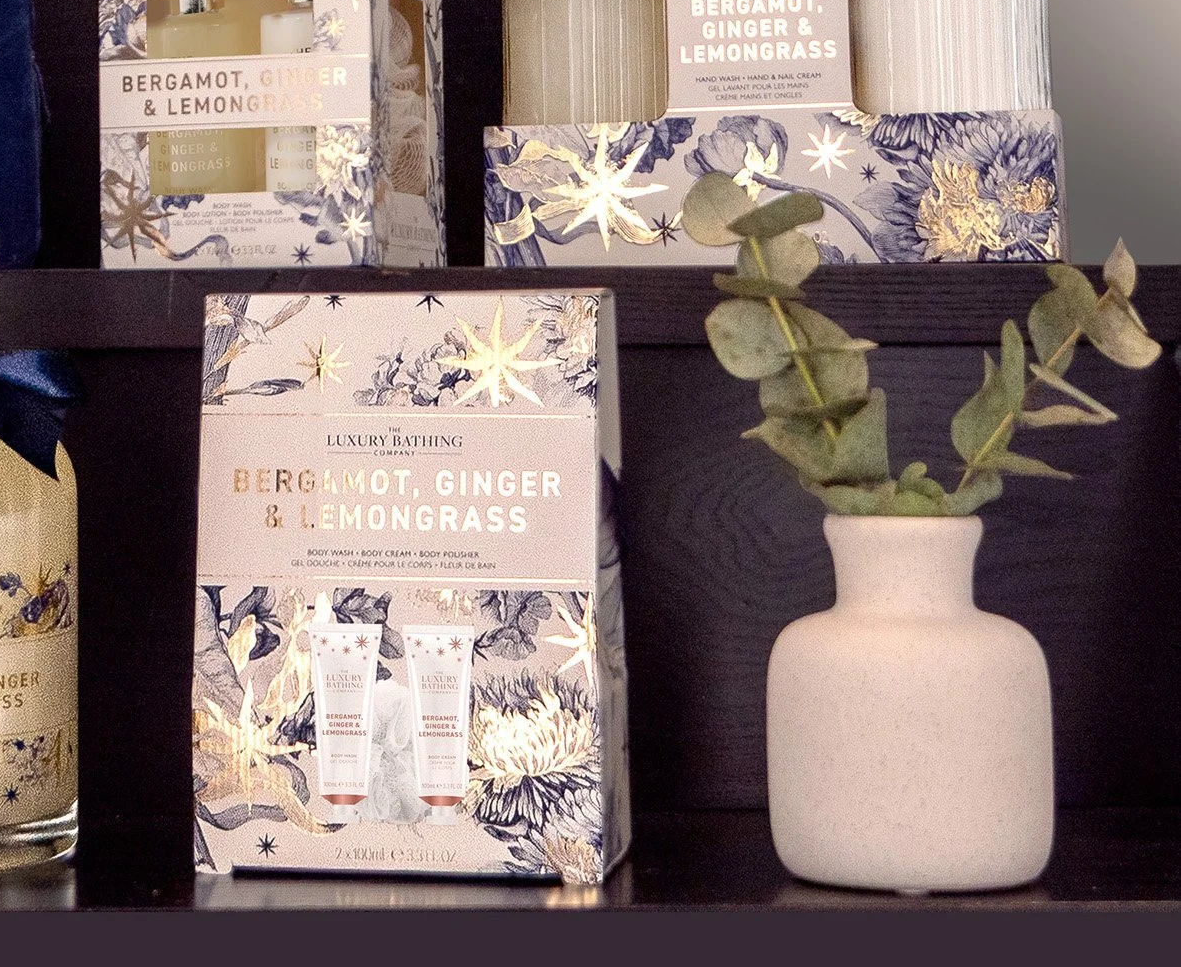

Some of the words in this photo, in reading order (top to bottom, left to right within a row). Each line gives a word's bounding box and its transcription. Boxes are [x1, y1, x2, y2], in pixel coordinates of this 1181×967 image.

[702, 18, 788, 39] GINGER
[796, 17, 813, 36] &
[679, 40, 837, 64] LEMONGRASS
[122, 71, 251, 93] BERGAMOT,
[796, 72, 822, 80] CREAM
[143, 100, 157, 117] &
[327, 434, 387, 448] LUXURY
[393, 435, 463, 448] BATHING
[233, 468, 422, 500] BERGAMOT,
[435, 470, 562, 499] GINGER
[265, 504, 284, 529] &
[299, 505, 529, 533] LEMONGRASS
[307, 549, 328, 557] BODY
[330, 549, 353, 557] WASH
[384, 550, 411, 558] CREAM
[418, 550, 440, 558] BODY
[326, 674, 363, 682] LUXURY
[326, 681, 364, 689] BATHING
[326, 714, 363, 722] BERGAMOT,
[422, 715, 459, 723] BERGAMOT,
